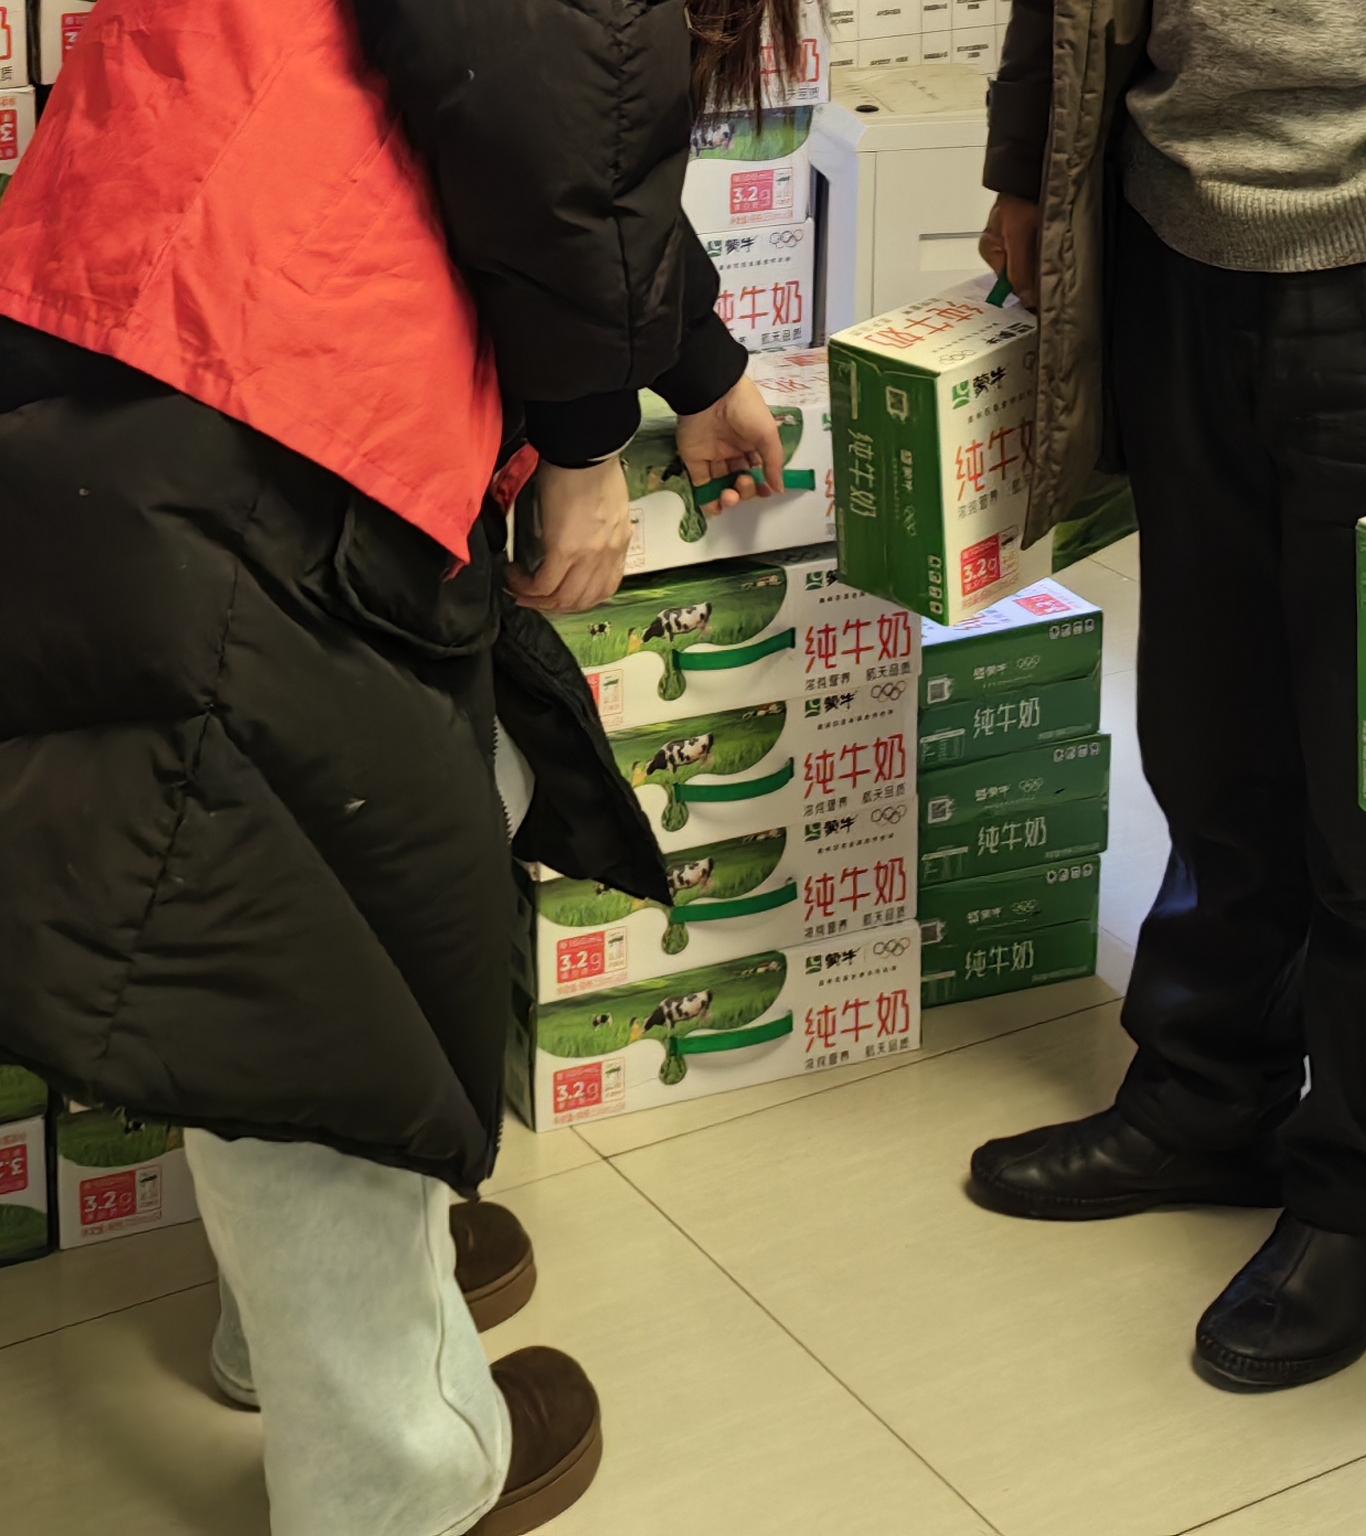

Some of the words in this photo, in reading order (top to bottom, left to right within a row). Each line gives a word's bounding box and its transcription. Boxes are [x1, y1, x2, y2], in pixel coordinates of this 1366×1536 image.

[726, 238, 753, 254] 蒙牛
[973, 367, 1006, 398] 蒙牛
[806, 612, 911, 671] 纯牛奶
[973, 696, 1040, 738] 纯牛奶
[805, 734, 905, 797] 纯牛奶
[979, 818, 1045, 854] 纯牛奶
[805, 858, 906, 918] 纯牛奶
[560, 950, 601, 973] 3.2g
[965, 940, 1033, 978] 纯牛奶
[806, 990, 909, 1050] 纯牛奶
[557, 1080, 599, 1104] 3.2g
[83, 1190, 132, 1212] 3.2g
